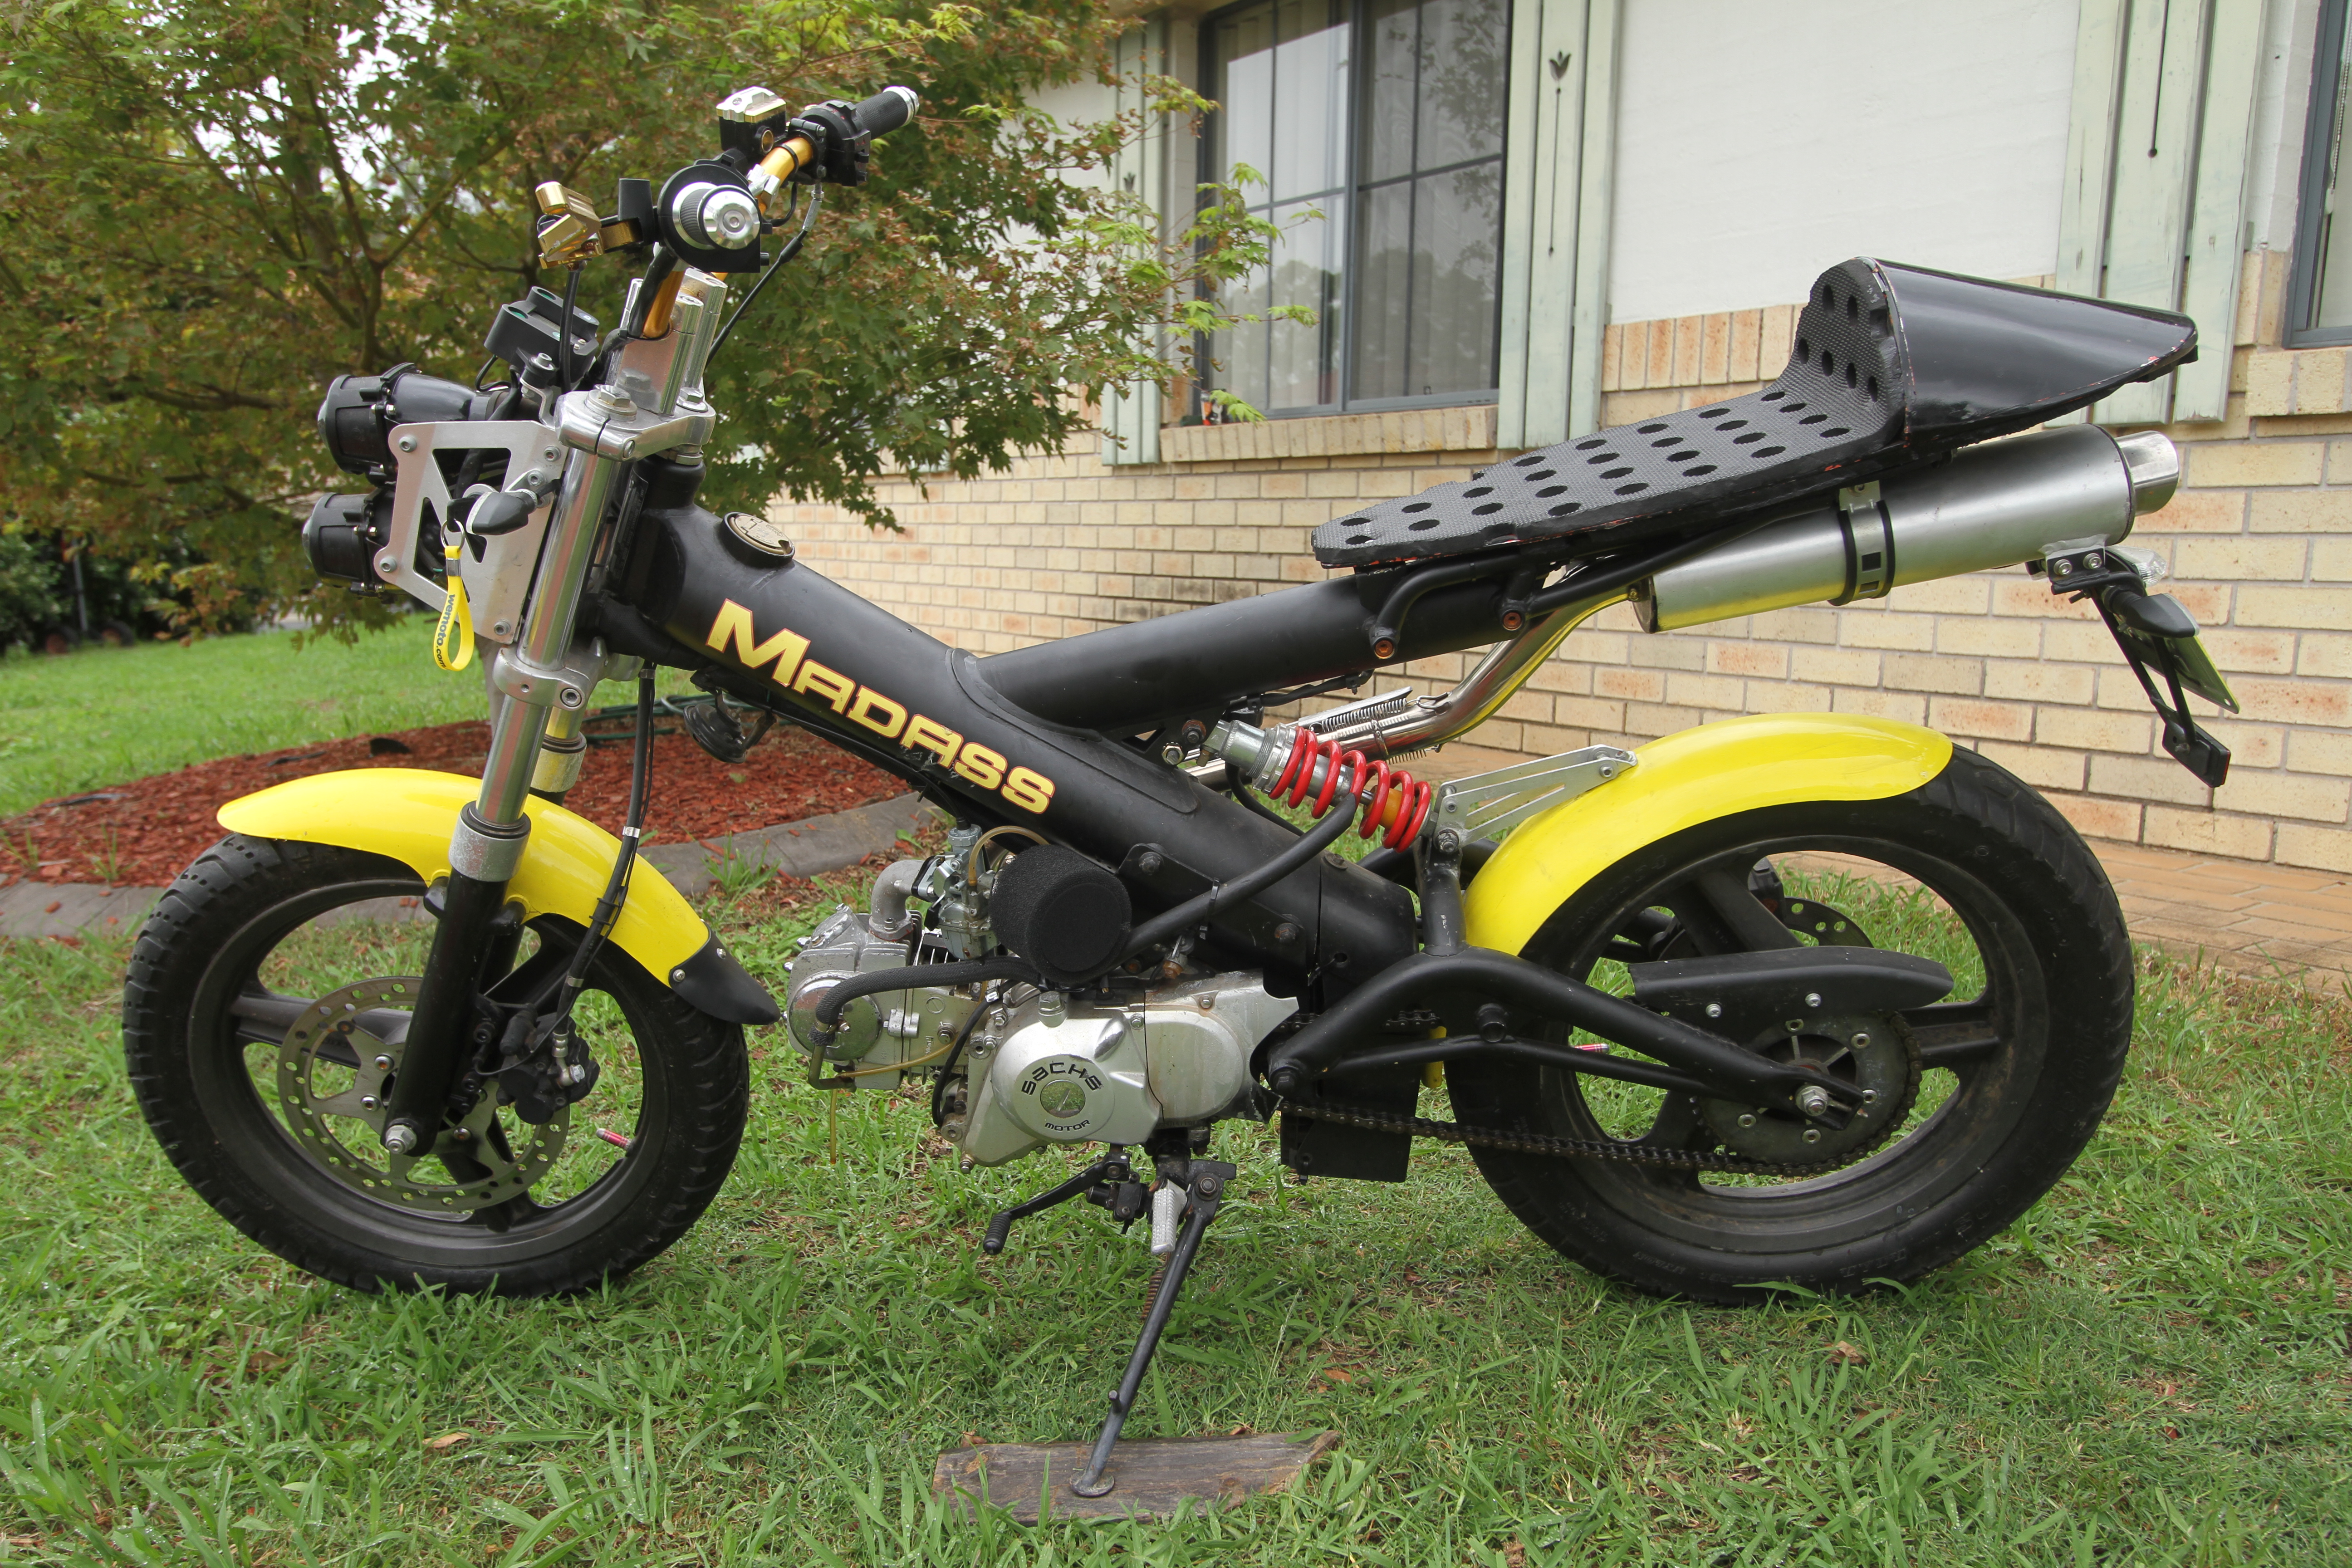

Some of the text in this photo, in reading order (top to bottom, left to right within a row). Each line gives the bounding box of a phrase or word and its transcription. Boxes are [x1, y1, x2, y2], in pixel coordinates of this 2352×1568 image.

[436, 594, 455, 668] wemoto.com
[706, 598, 1056, 814] MADASS
[1021, 1062, 1104, 1096] SACHS
[1044, 1119, 1091, 1132] MOTOR
